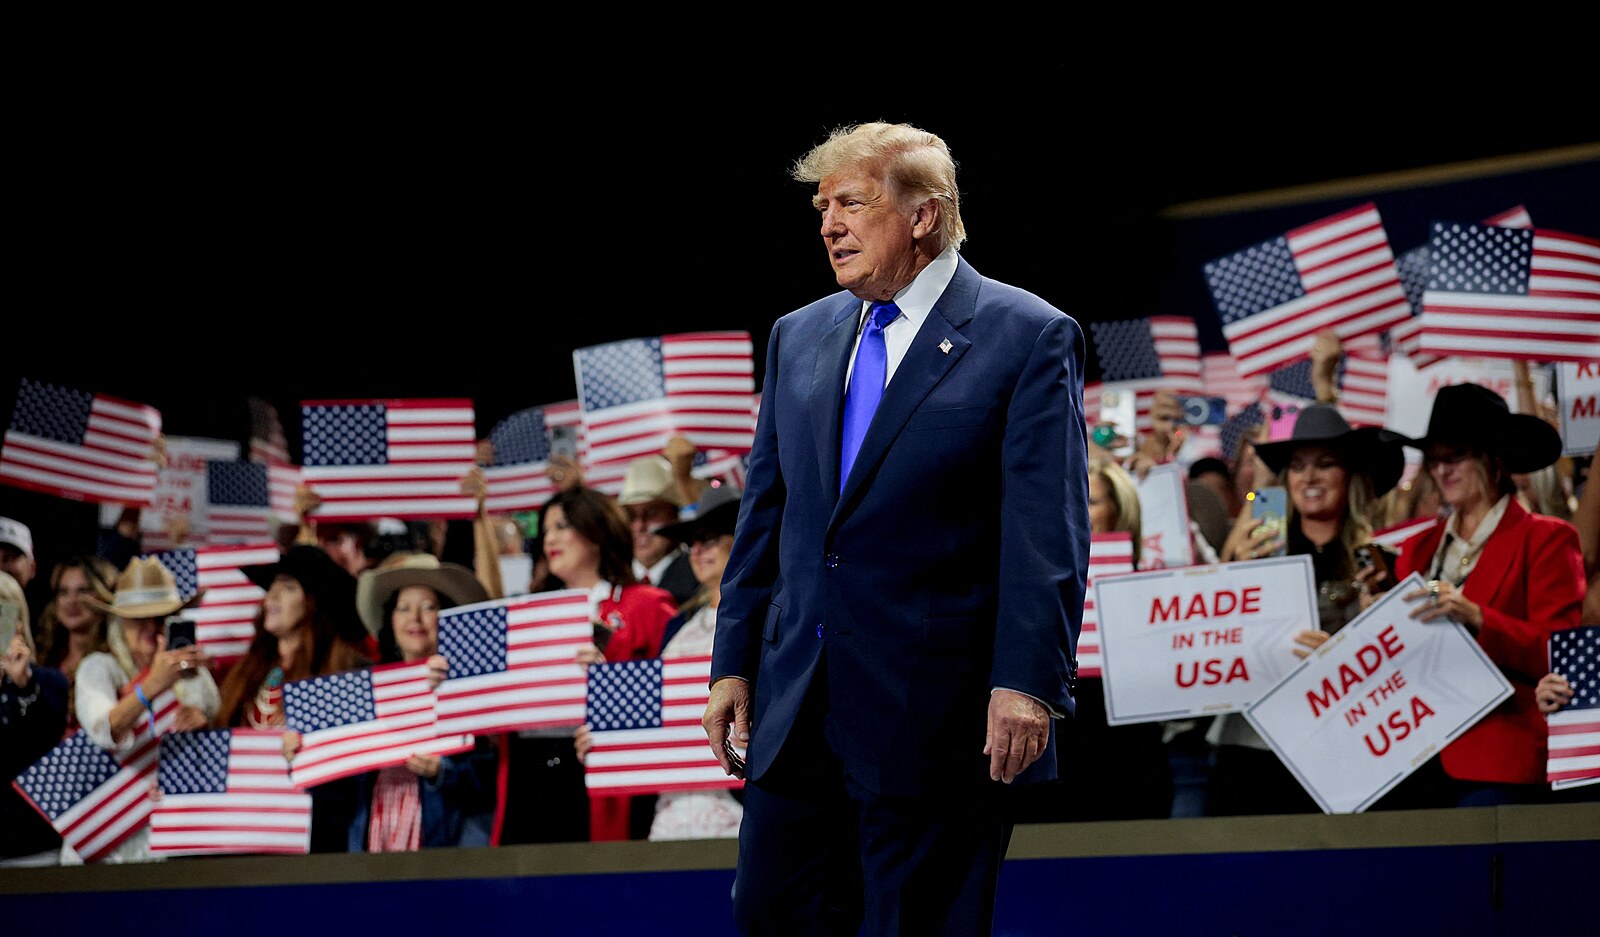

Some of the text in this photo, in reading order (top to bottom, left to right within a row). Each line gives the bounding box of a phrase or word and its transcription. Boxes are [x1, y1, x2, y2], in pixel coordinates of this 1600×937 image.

[1149, 586, 1262, 625] MADE
[1173, 627, 1243, 649] IN THE
[1175, 657, 1249, 689] USA
[1305, 624, 1406, 718] MADE
[1344, 670, 1407, 727] IN THE
[1364, 696, 1435, 757] USA
